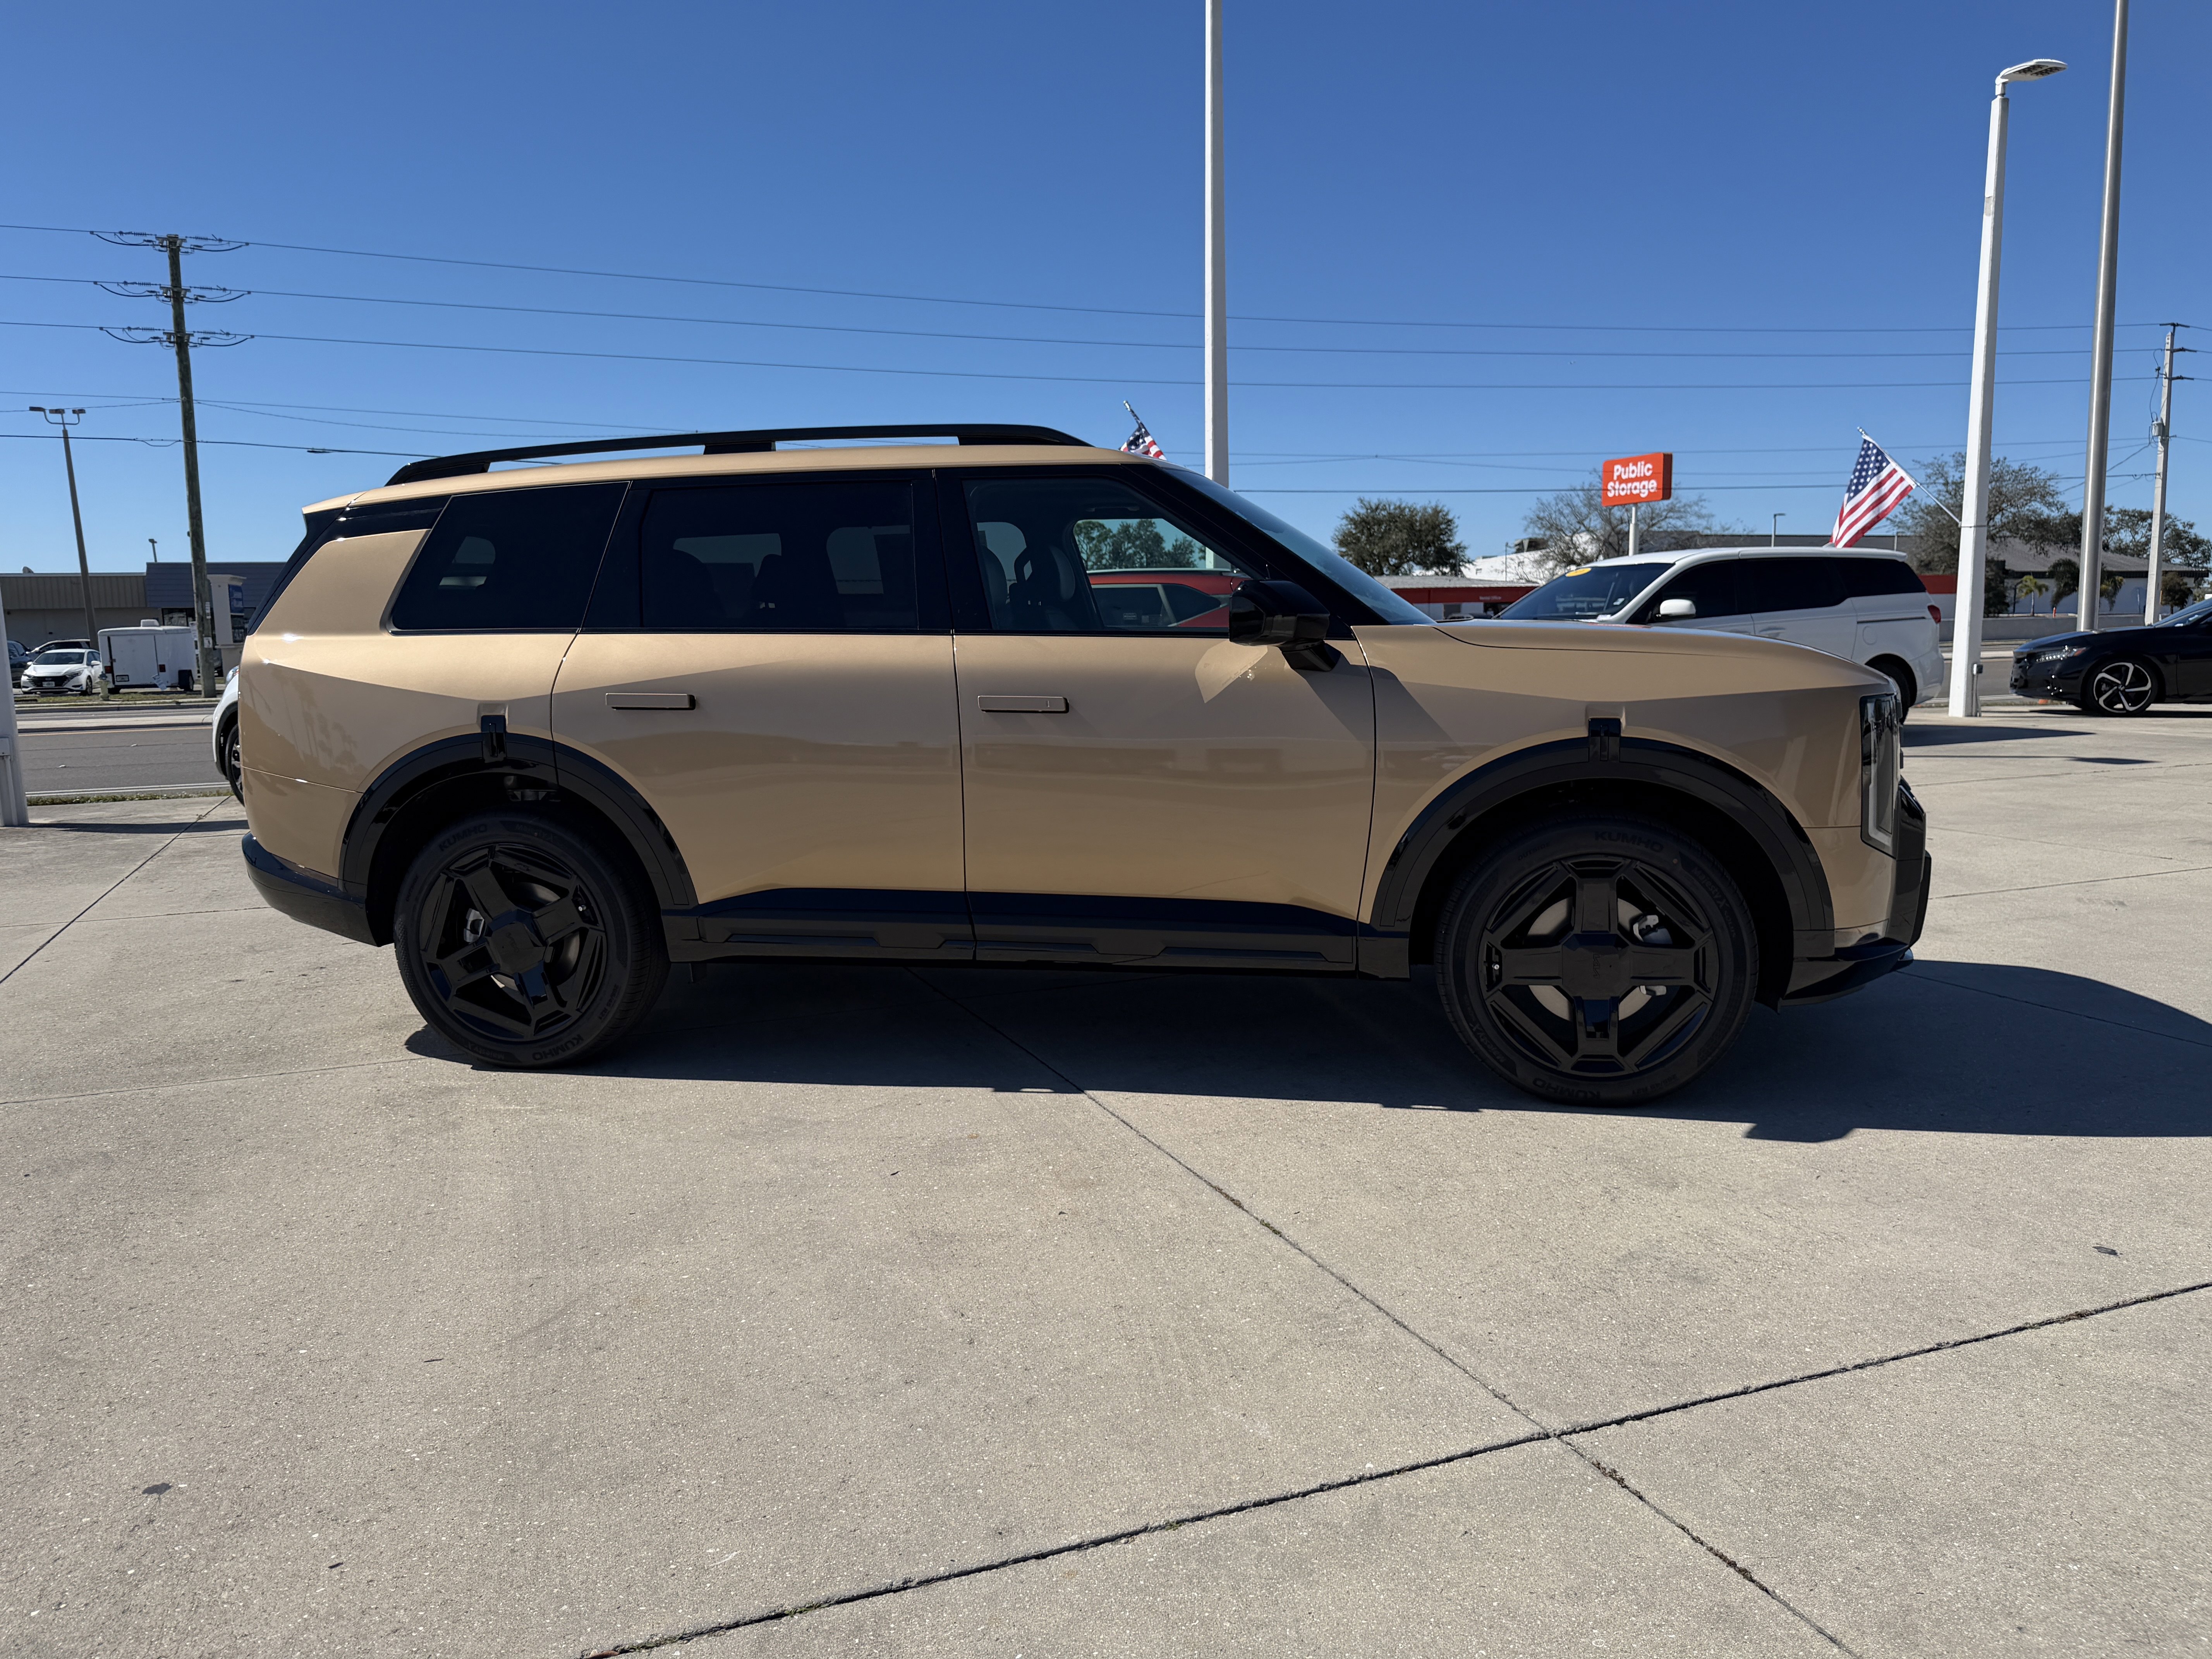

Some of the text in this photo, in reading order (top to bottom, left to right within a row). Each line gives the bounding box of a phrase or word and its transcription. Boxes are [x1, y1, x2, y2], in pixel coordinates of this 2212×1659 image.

[1613, 461, 1653, 481] Public
[1607, 479, 1657, 498] Storage
[439, 824, 488, 852] KUMHO
[1594, 831, 1663, 852] KUMHO
[532, 1034, 584, 1060] KUMHO
[1532, 1078, 1602, 1100] KUMHO
